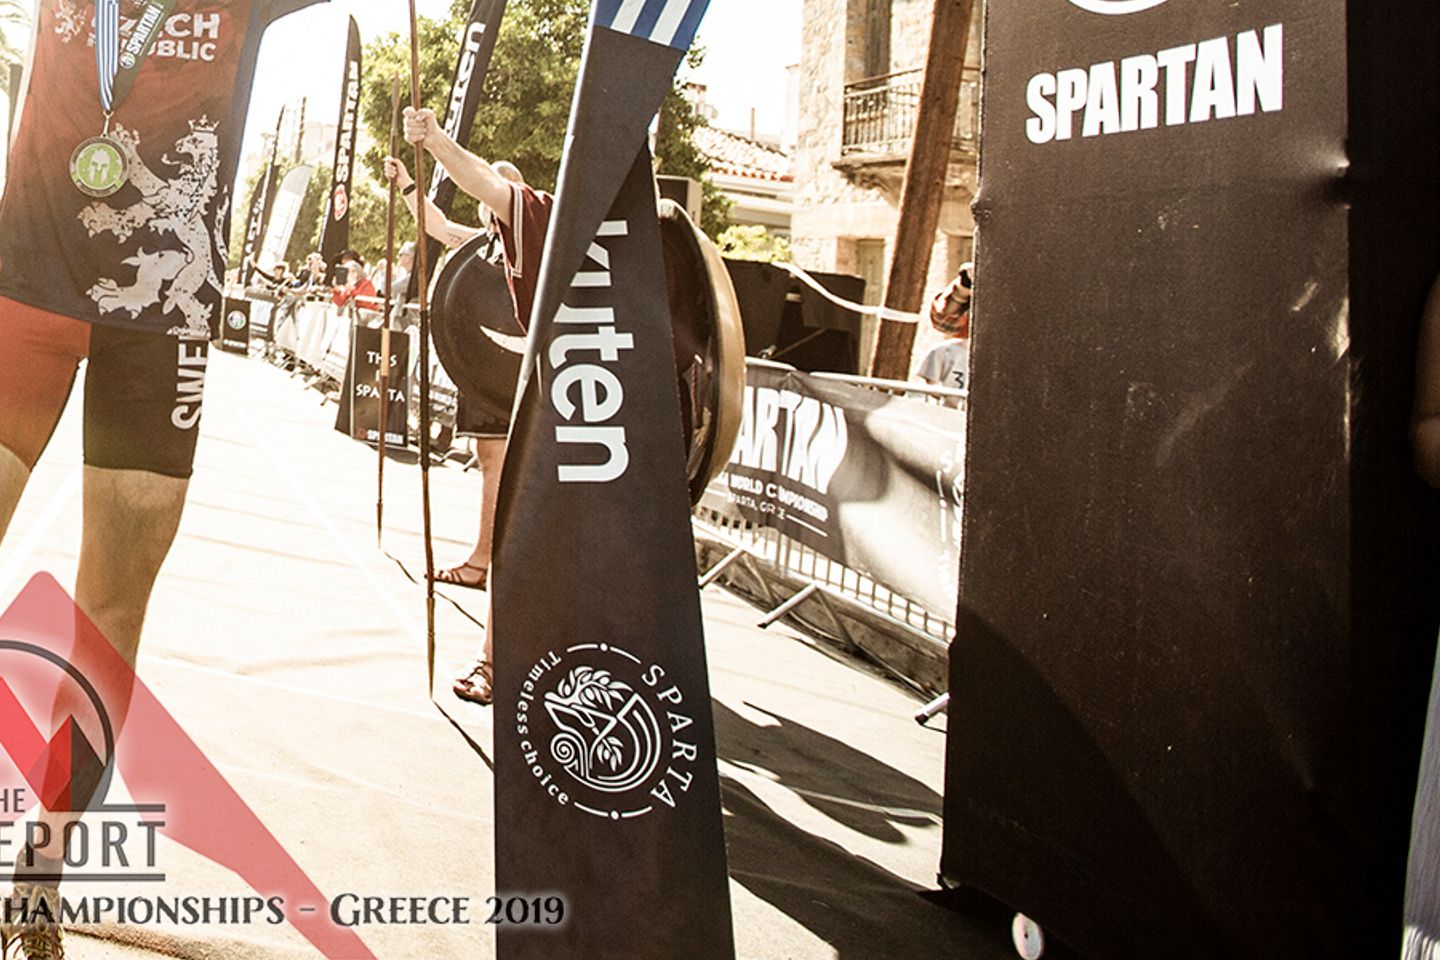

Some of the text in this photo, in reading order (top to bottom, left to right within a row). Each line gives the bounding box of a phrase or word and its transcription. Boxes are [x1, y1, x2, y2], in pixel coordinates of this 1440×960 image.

[91, 13, 221, 39] ZCH
[126, 4, 161, 55] SPARTAN
[1026, 23, 1283, 144] SPARTAN
[367, 351, 397, 367] THS
[356, 383, 405, 402] SPATA
[728, 386, 848, 495] ARTAN
[516, 651, 562, 736] Timeless
[641, 664, 698, 809] SPARTA
[520, 741, 570, 806] choice
